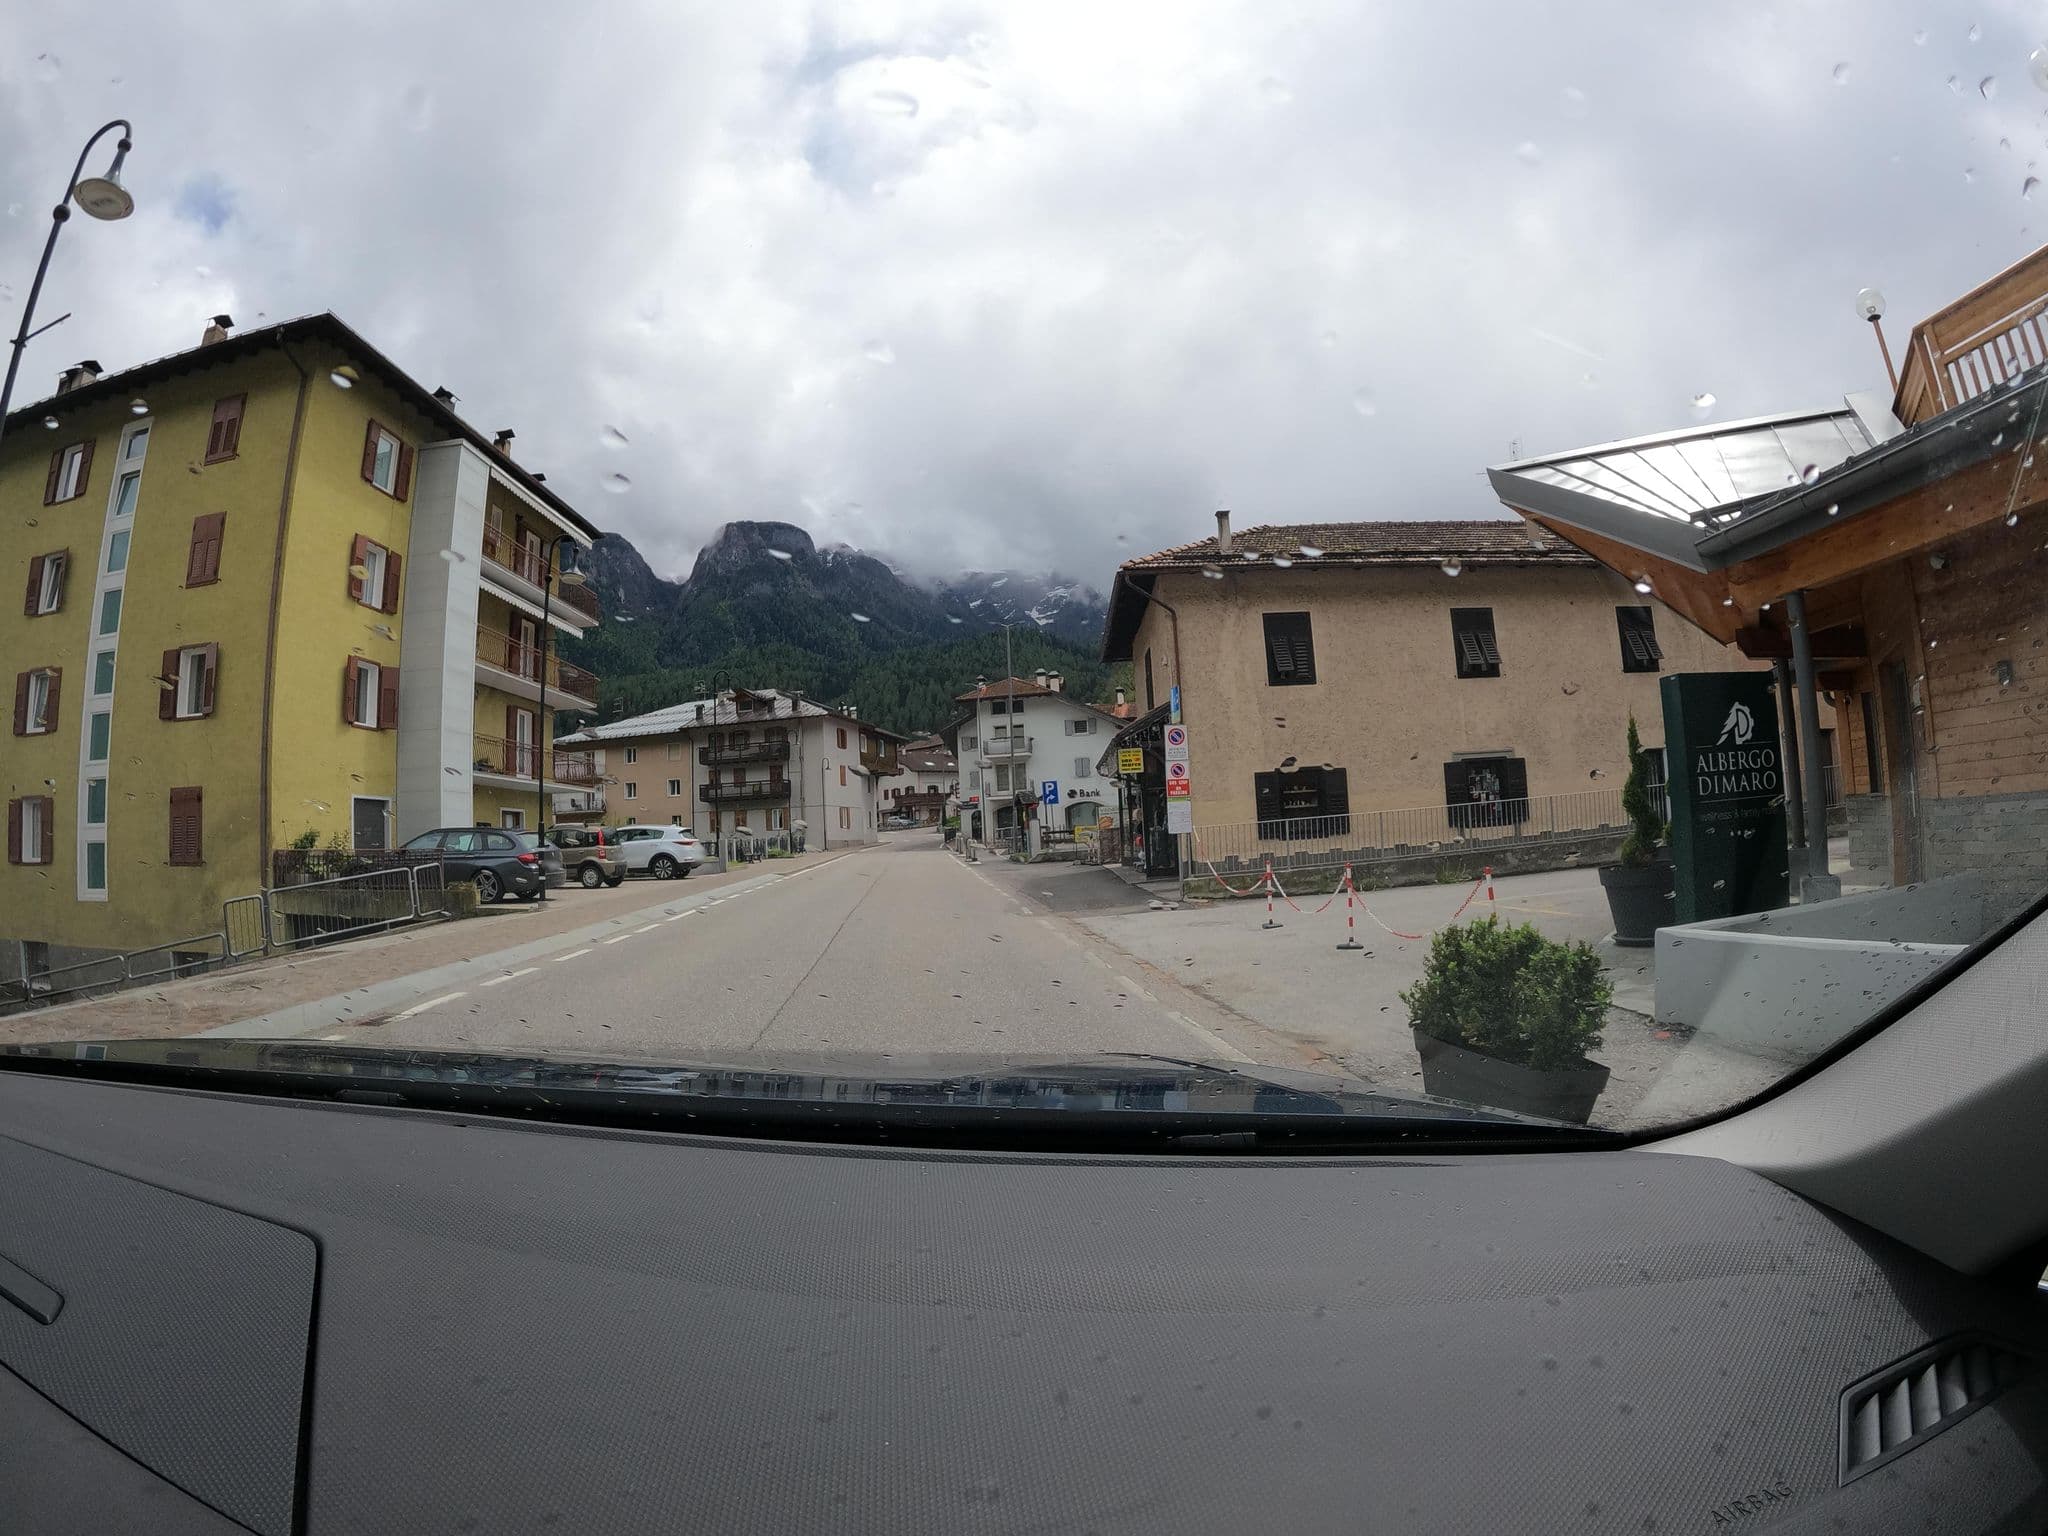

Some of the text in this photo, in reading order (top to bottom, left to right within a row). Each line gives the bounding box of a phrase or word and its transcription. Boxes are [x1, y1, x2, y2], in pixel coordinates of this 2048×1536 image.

[1696, 748, 1775, 773] ALBERGO
[1045, 782, 1055, 794] P
[1079, 788, 1101, 798] Bank
[1697, 770, 1777, 796] DIMARO
[1711, 1481, 1793, 1528] AIRBAG
